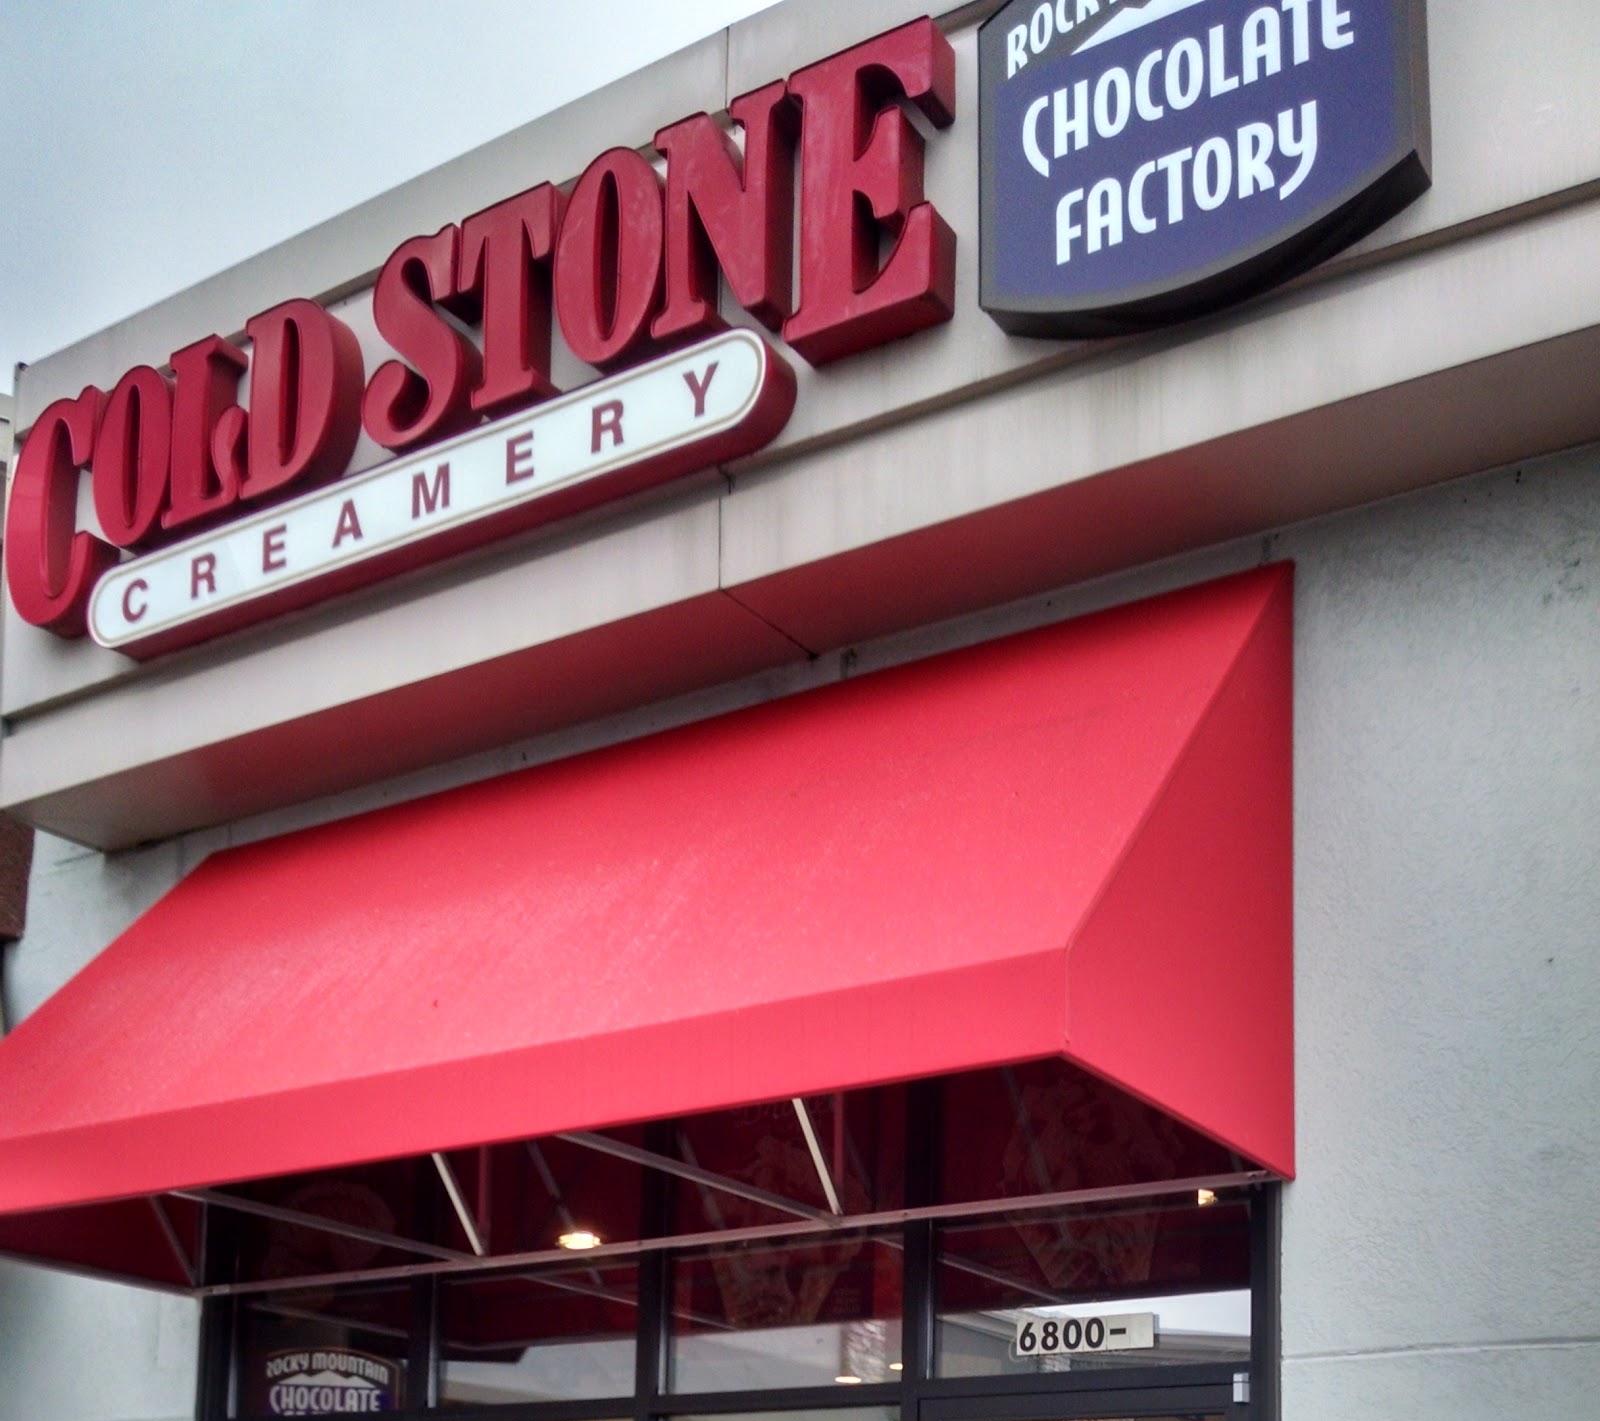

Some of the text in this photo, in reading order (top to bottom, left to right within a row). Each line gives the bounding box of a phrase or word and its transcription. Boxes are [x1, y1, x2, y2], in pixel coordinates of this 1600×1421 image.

[1007, 0, 1117, 80] ROCK
[1022, 0, 1354, 178] CHOCOLATE
[1056, 100, 1318, 266] FACTORY
[5, 16, 955, 636] COLD STONE
[121, 362, 718, 623] CREAMERY
[269, 1385, 381, 1414] CHOCOLATE
[312, 1352, 389, 1385] MOUNTAIN
